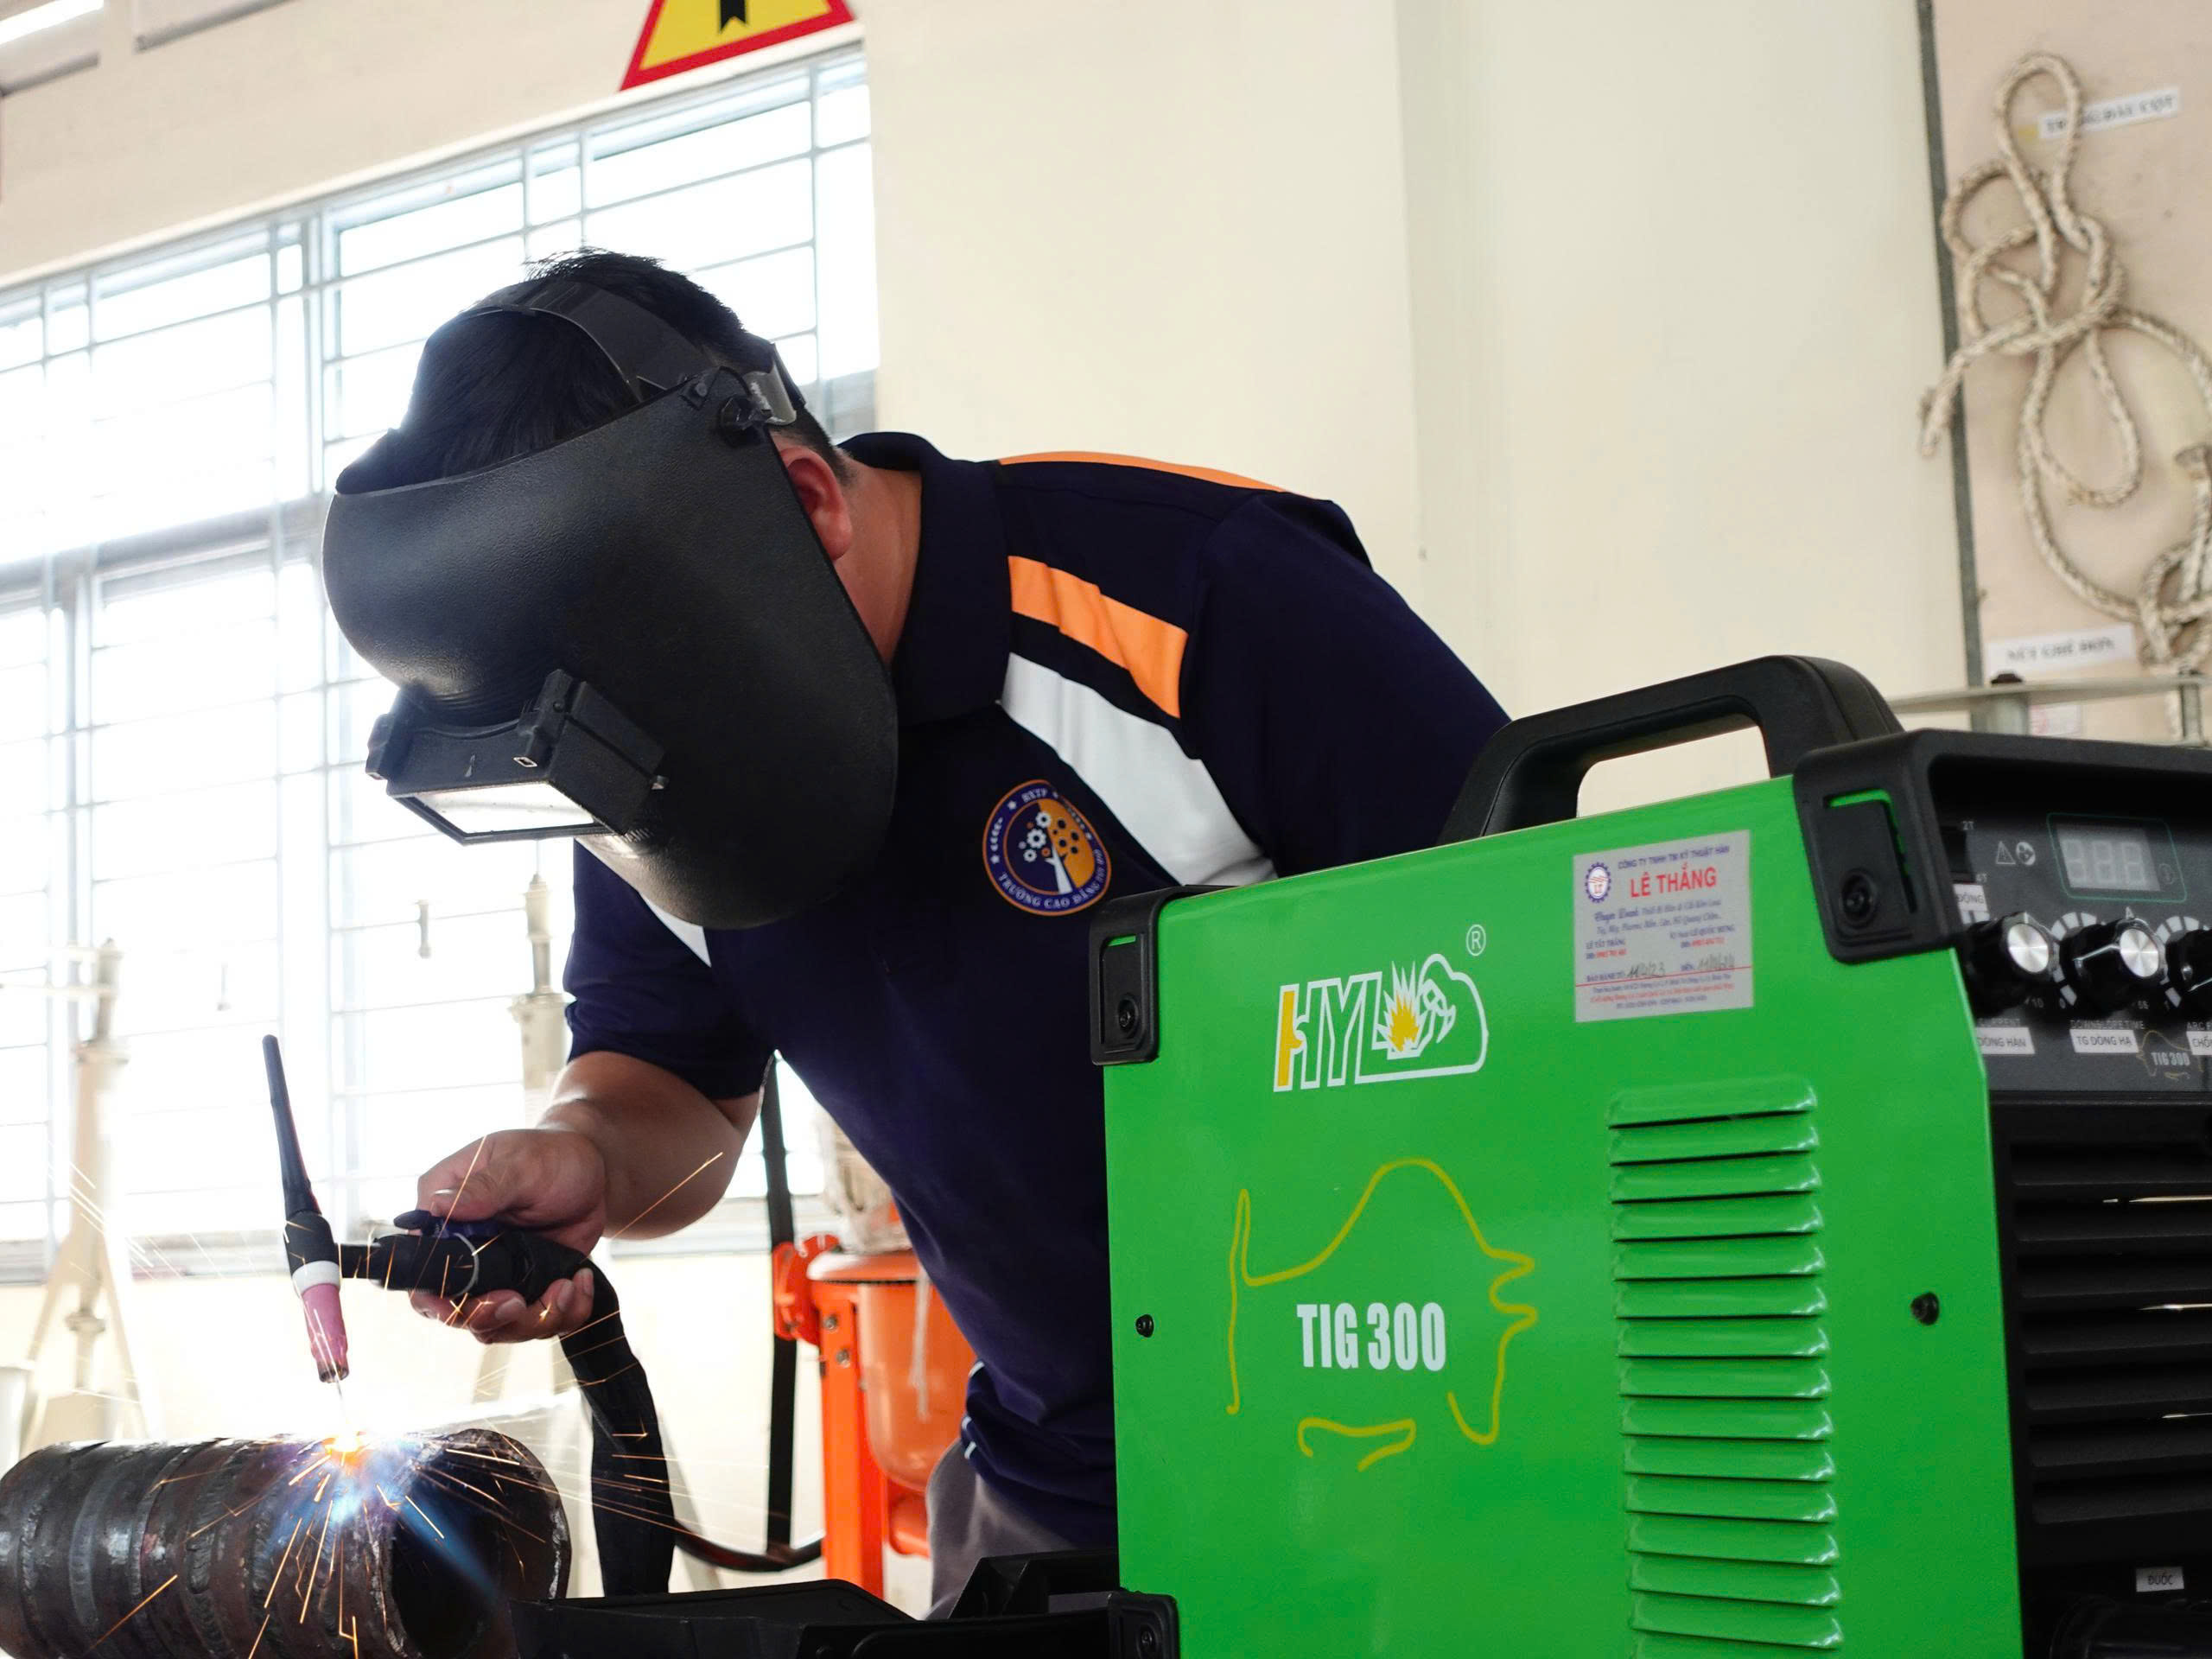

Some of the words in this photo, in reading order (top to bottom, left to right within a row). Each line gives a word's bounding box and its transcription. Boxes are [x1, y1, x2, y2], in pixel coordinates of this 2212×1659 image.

[1630, 871, 1651, 898] LÊ
[1657, 861, 1717, 894] THẮNG
[1044, 897, 1071, 909] CAO
[2151, 1051, 2170, 1066] TIG
[1297, 1303, 1358, 1370] TIG
[1366, 1302, 1446, 1371] 300
